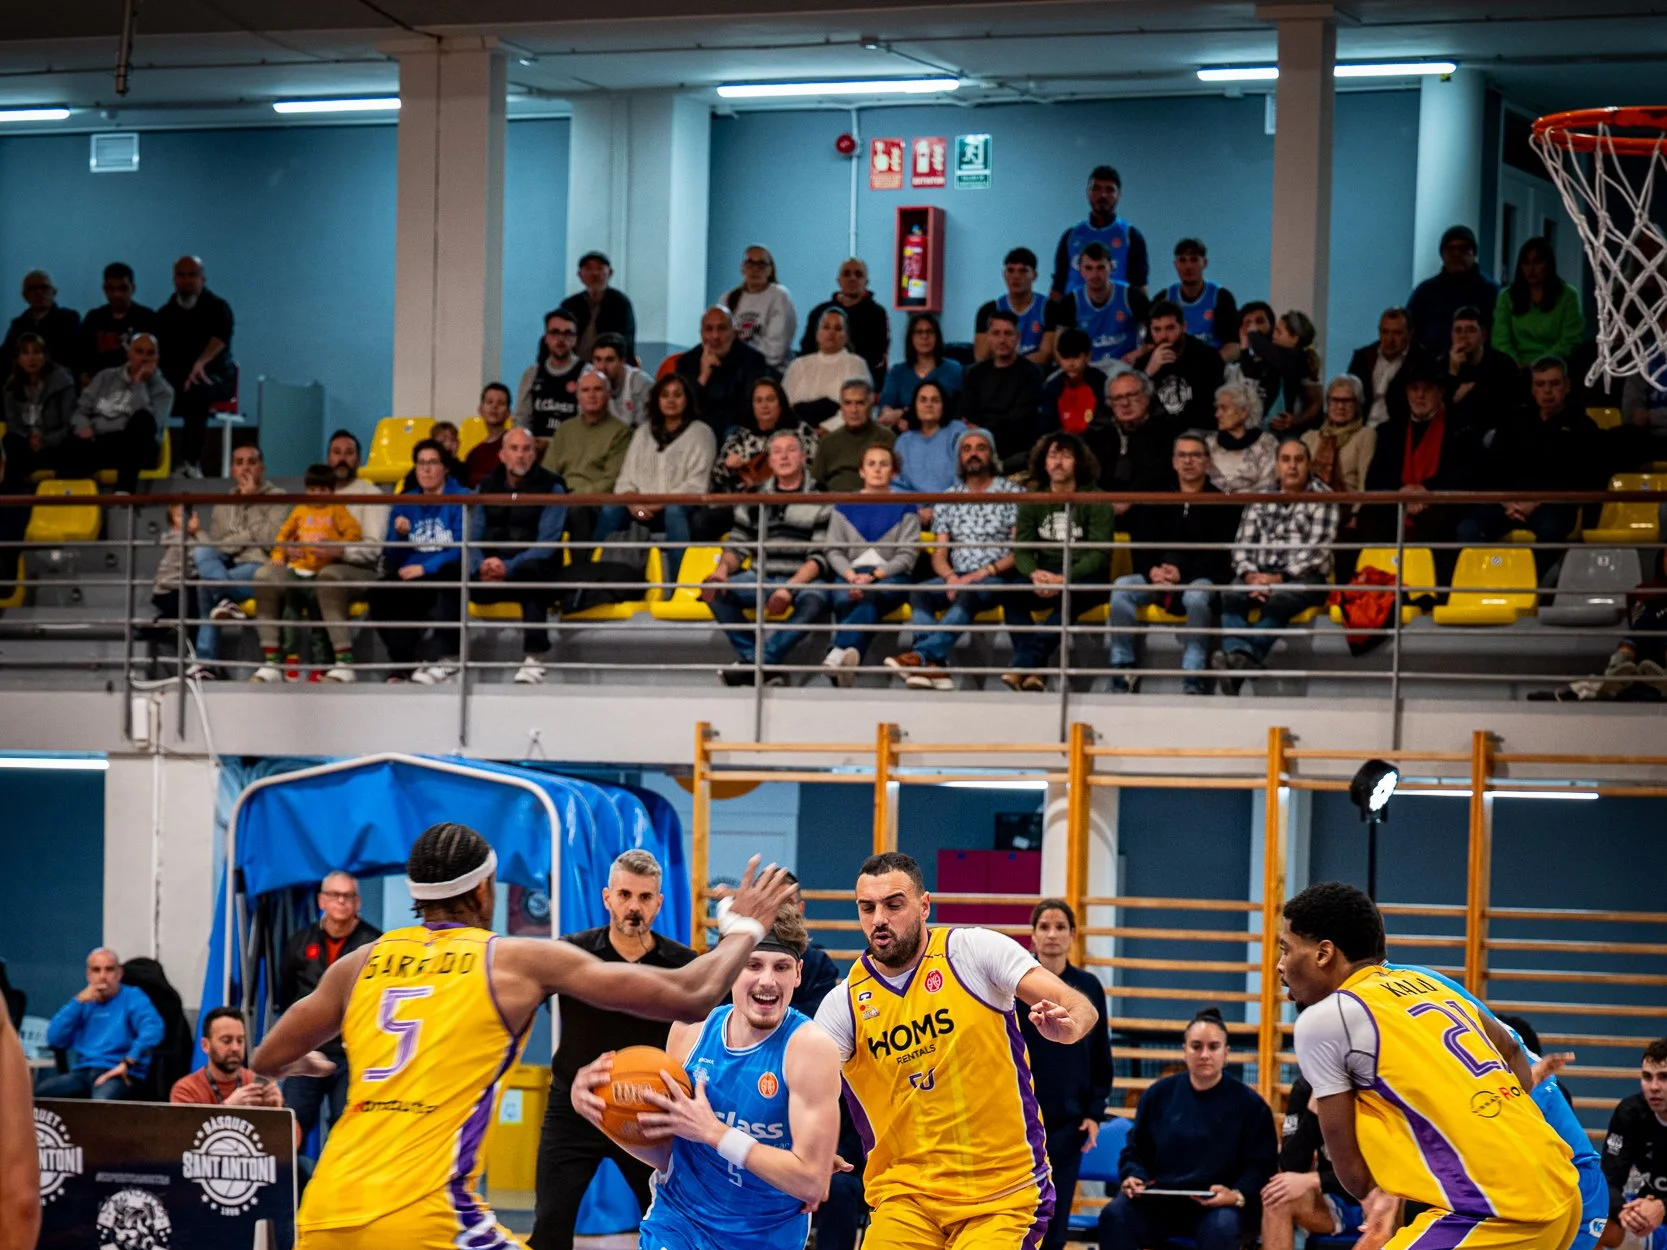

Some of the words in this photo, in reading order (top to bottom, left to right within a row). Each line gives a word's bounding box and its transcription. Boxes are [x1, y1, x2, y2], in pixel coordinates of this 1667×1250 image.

[1381, 978, 1438, 998] KALU
[360, 985, 434, 1083] 5
[867, 1008, 955, 1060] HOMS
[896, 1043, 937, 1065] RENTALS
[38, 1146, 84, 1174] NTONI
[182, 1151, 221, 1179] SANT
[221, 1154, 277, 1184] ANTONI
